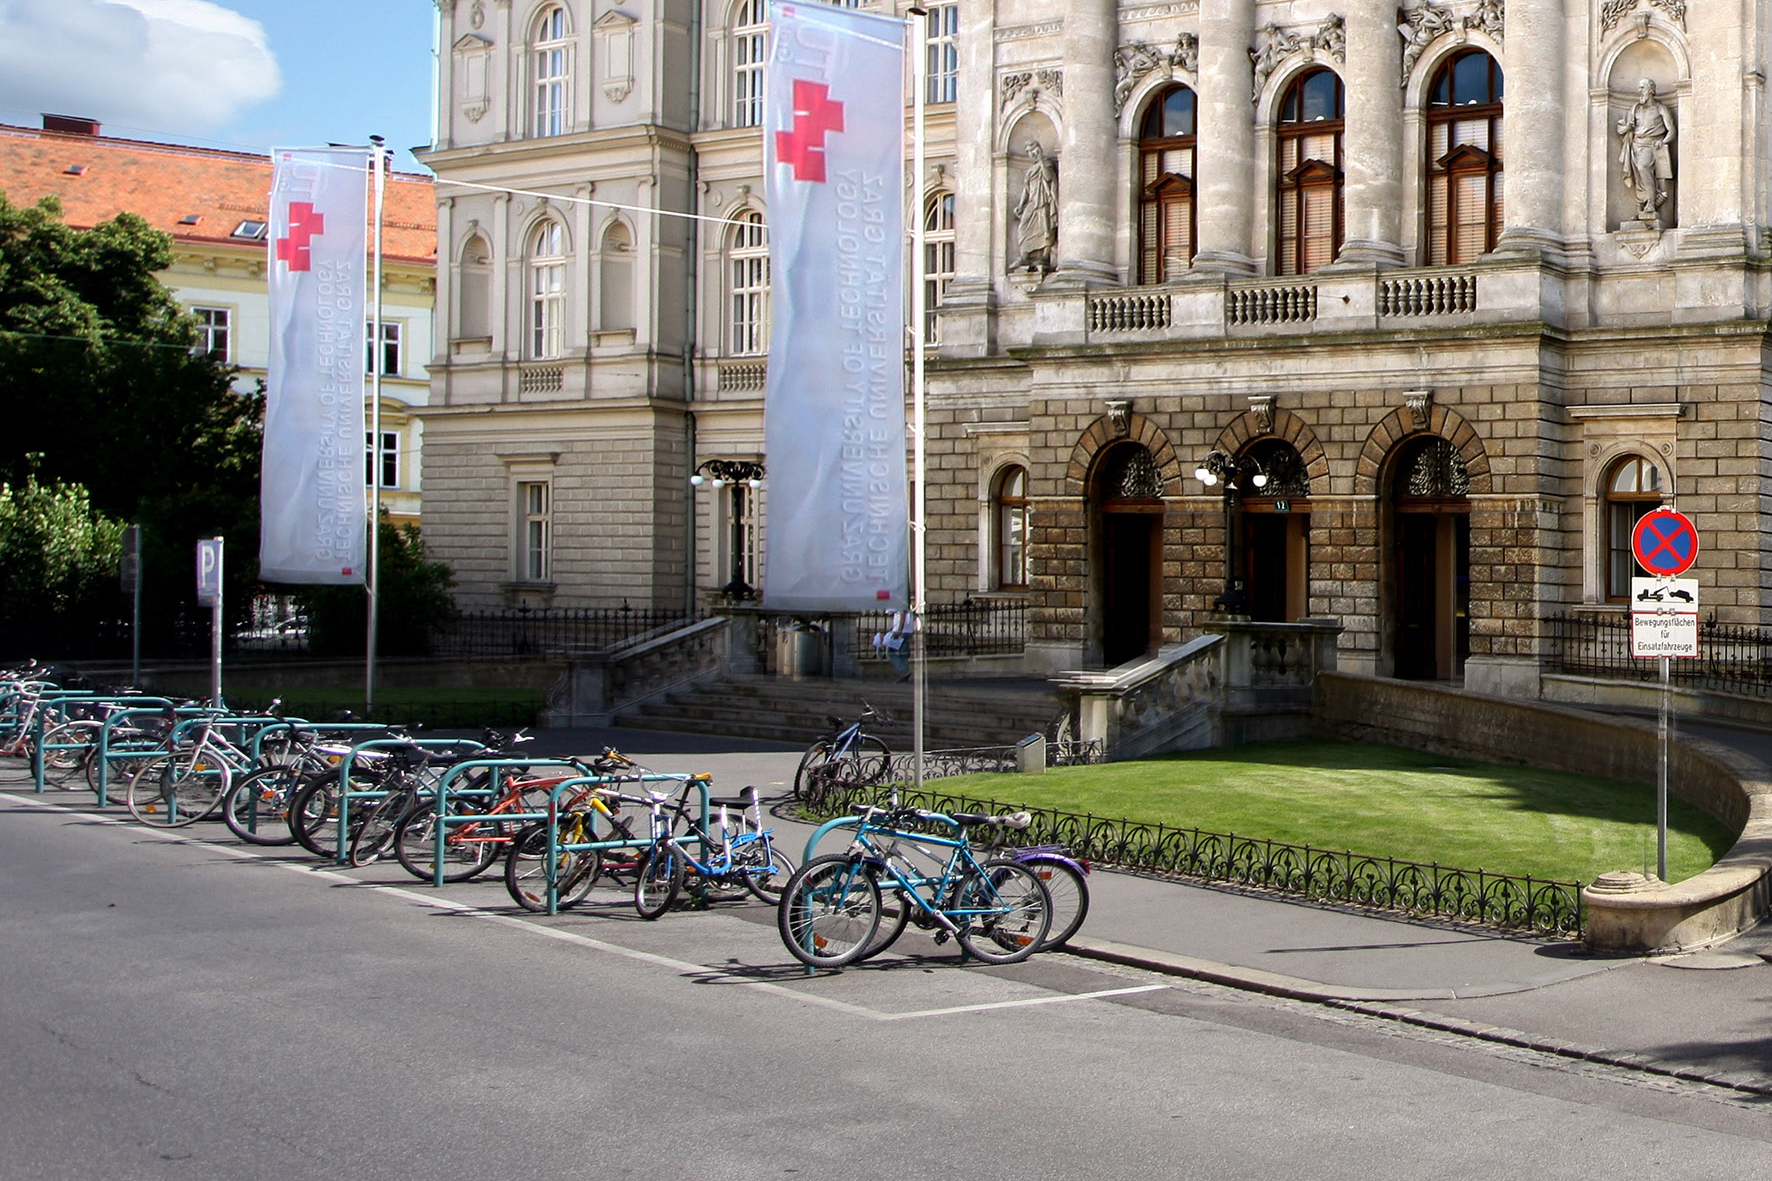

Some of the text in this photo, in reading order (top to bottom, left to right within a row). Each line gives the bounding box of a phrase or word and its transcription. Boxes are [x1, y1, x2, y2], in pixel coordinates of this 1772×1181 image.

[1276, 501, 1286, 510] 12
[202, 545, 215, 588] P
[1634, 617, 1695, 628] Bewegungsflächen
[1660, 629, 1670, 639] für
[1637, 641, 1693, 653] Einsatzfahrzeuge
